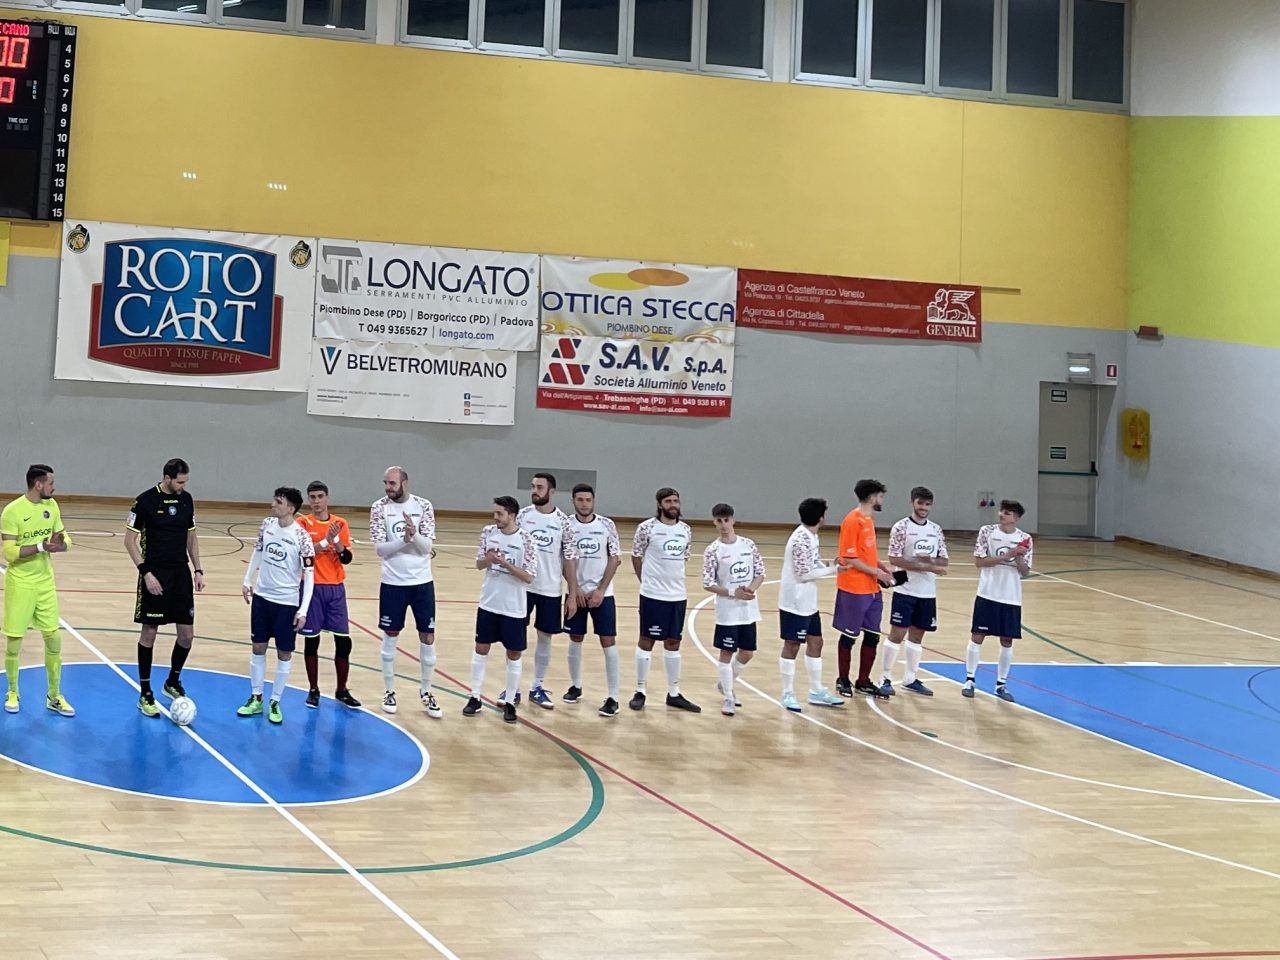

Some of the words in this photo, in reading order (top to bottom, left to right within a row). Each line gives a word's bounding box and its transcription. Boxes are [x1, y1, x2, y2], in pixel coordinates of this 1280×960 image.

[117, 245, 263, 297] ROTO
[367, 257, 530, 297] LONGATO
[367, 290, 436, 300] SERRAMENTI
[467, 297, 528, 306] ALLUMINIO
[744, 281, 775, 292] Agenzia
[778, 284, 785, 292] di
[787, 284, 836, 296] Castelfranco
[839, 288, 865, 298] Veneto
[542, 291, 632, 316] OTTICA
[642, 298, 735, 322] STECCA
[742, 306, 775, 317] Agenzia
[778, 309, 785, 317] di
[786, 309, 825, 320] Cittadella
[114, 293, 256, 343] CART
[320, 304, 361, 316] Piombino
[364, 308, 384, 317] Dese
[387, 309, 407, 320] (PD)
[417, 311, 466, 323] Borgoricco
[469, 314, 490, 325] (PD)
[501, 317, 534, 327] Padova
[359, 323, 365, 332] T
[367, 324, 385, 334] 049
[388, 326, 428, 336] 9365627
[439, 329, 494, 341] longato.com
[607, 322, 650, 333] PIOMBINO
[652, 325, 673, 335] DESE
[927, 324, 976, 338] GENERALI
[123, 347, 172, 359] QUALITY
[176, 349, 209, 360] TISSUE
[212, 351, 242, 364] PAPER
[599, 343, 670, 371] S.A.V.
[683, 357, 727, 377] S.p.A.
[347, 354, 507, 378] BELVETROMURANO
[594, 375, 635, 388] Società
[638, 380, 687, 390] Alluminio
[691, 381, 726, 392] Veneto
[604, 394, 649, 404] Trebaseleghe
[651, 396, 666, 405] (PD)
[269, 547, 283, 557] DAG
